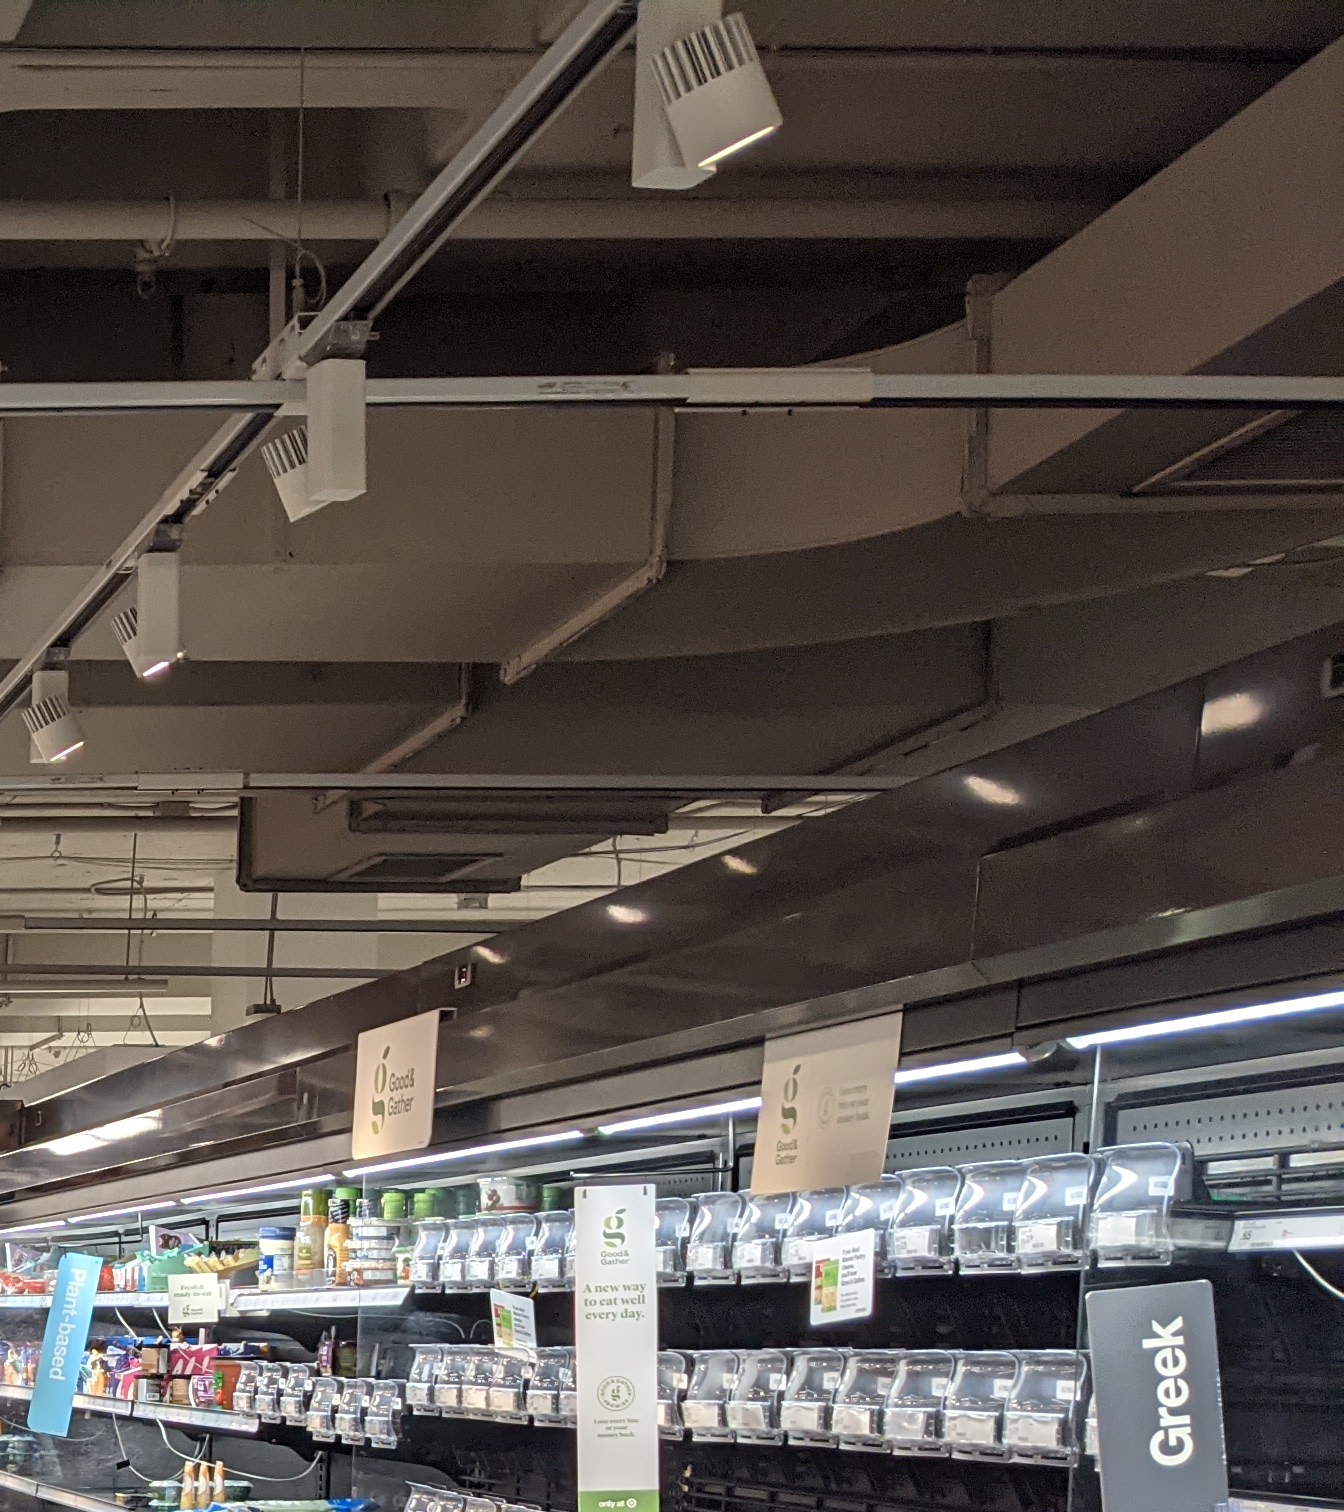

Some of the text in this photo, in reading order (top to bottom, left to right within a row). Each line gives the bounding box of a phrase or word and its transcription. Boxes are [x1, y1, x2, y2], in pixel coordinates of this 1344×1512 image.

[387, 1093, 414, 1117] Gather
[600, 1258, 630, 1266] Gather
[583, 1282, 647, 1294] A new way
[584, 1294, 646, 1307] to eat well
[585, 1308, 645, 1322] every day.
[48, 1267, 87, 1382] Plant-based
[1141, 1315, 1194, 1467] Greek
[598, 1500, 625, 1509] only at
